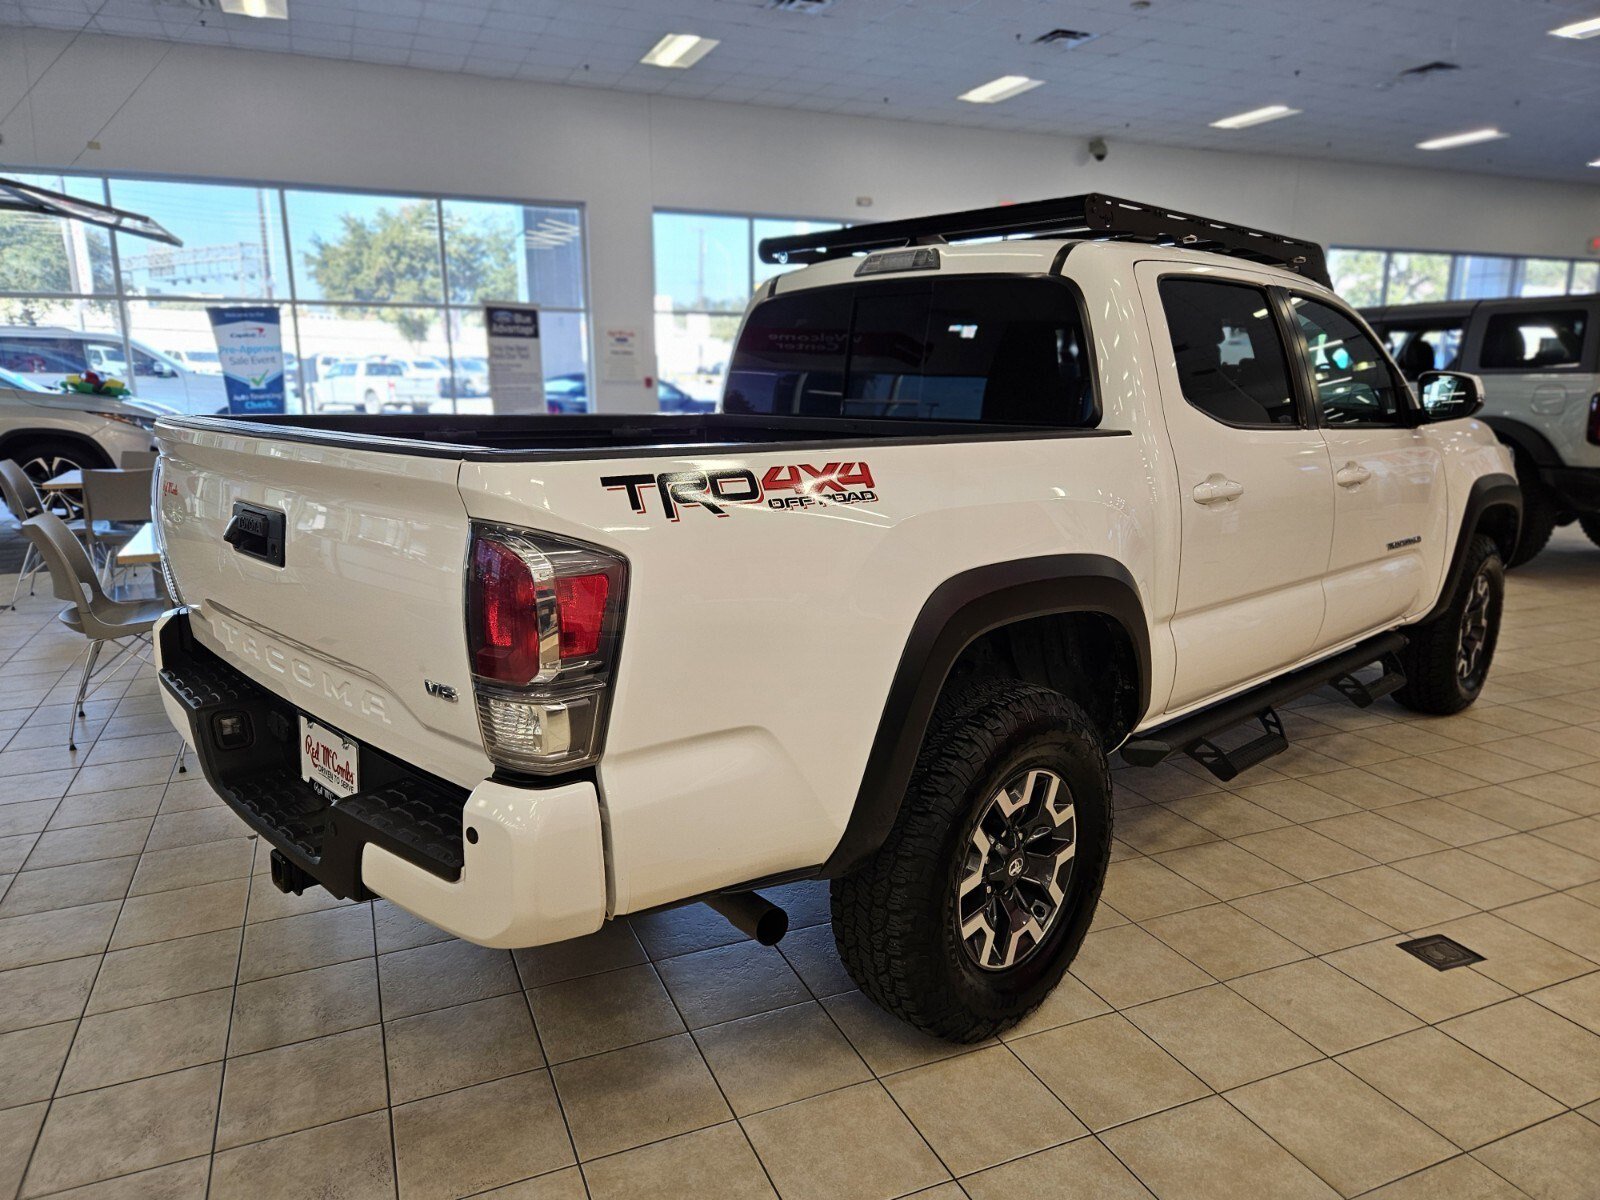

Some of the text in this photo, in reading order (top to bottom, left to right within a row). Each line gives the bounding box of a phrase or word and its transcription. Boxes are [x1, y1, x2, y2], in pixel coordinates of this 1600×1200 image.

[229, 355, 277, 366] Sale Event
[600, 468, 765, 522] TRD
[768, 496, 815, 511] OFF
[221, 620, 392, 725] TACOMA
[424, 678, 460, 704] V6
[305, 734, 354, 785] Red McCombs
[317, 764, 354, 794] DRIVEN TO SERVE
